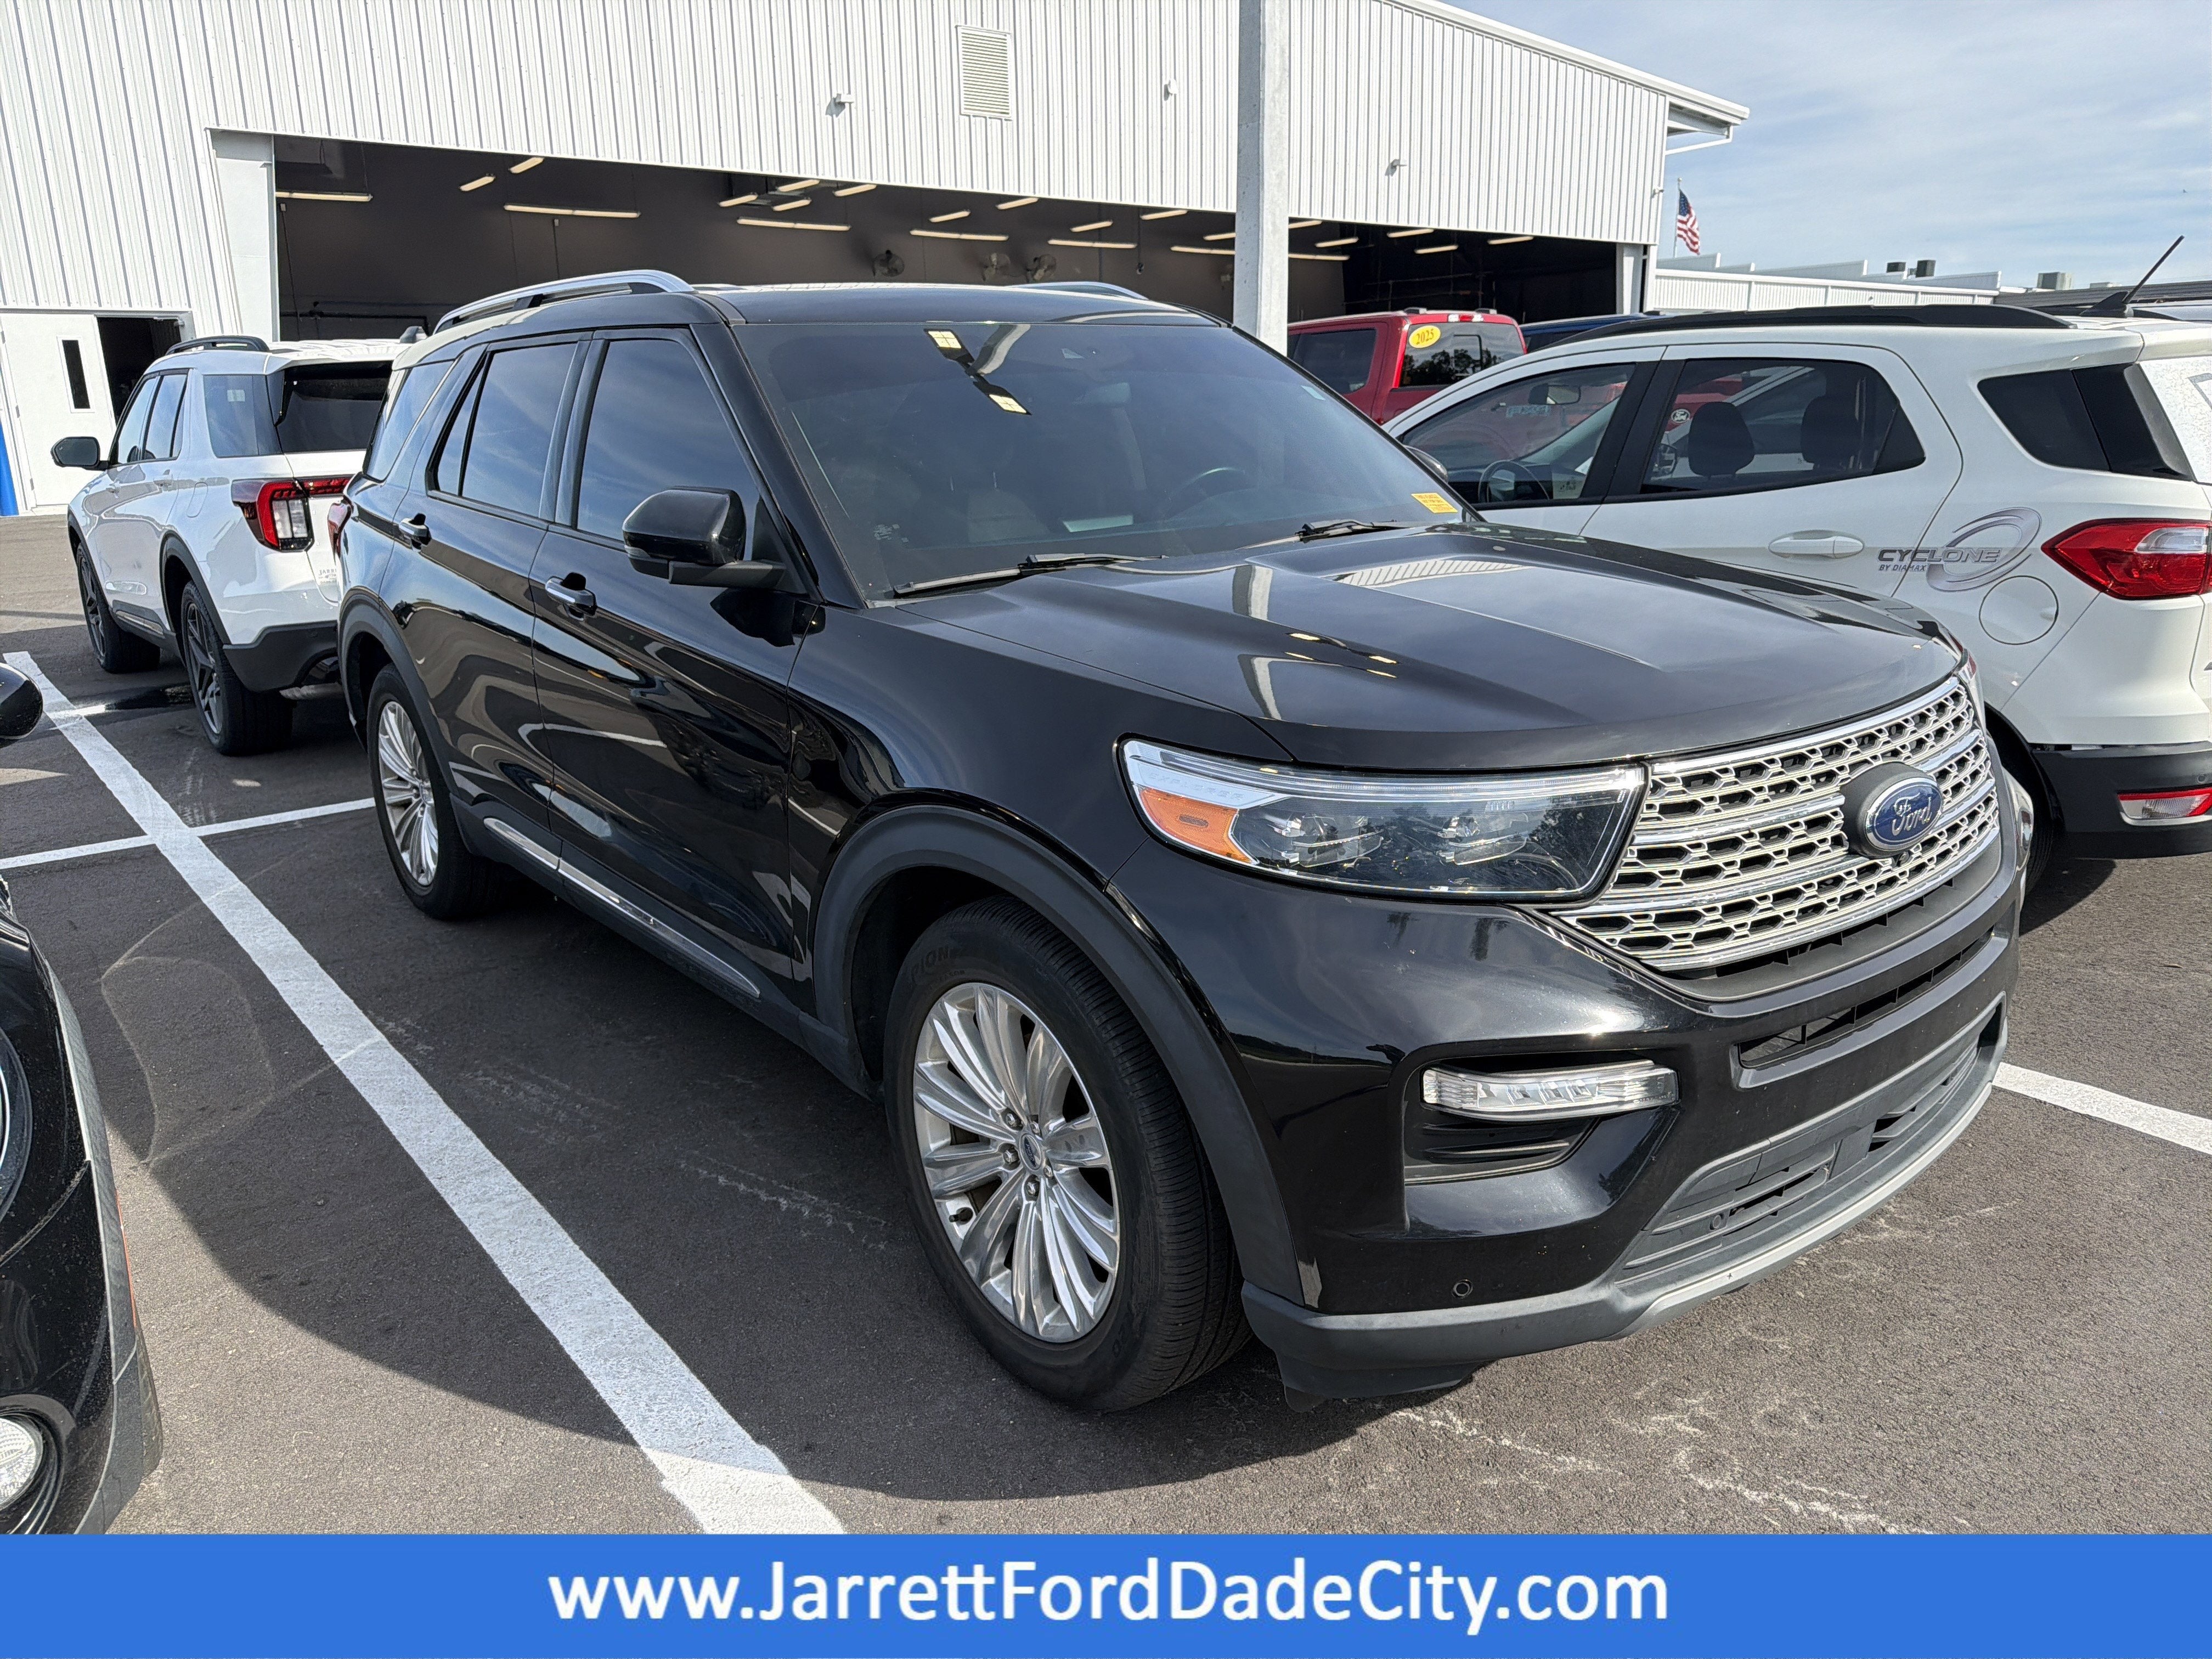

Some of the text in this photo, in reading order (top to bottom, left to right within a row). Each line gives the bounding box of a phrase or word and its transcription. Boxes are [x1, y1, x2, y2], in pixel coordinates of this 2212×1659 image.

[1415, 328, 1434, 345] 2025
[1877, 549, 2002, 563] CYCLONE
[1892, 563, 1928, 572] DIAMAX
[1891, 792, 1933, 837] Ford
